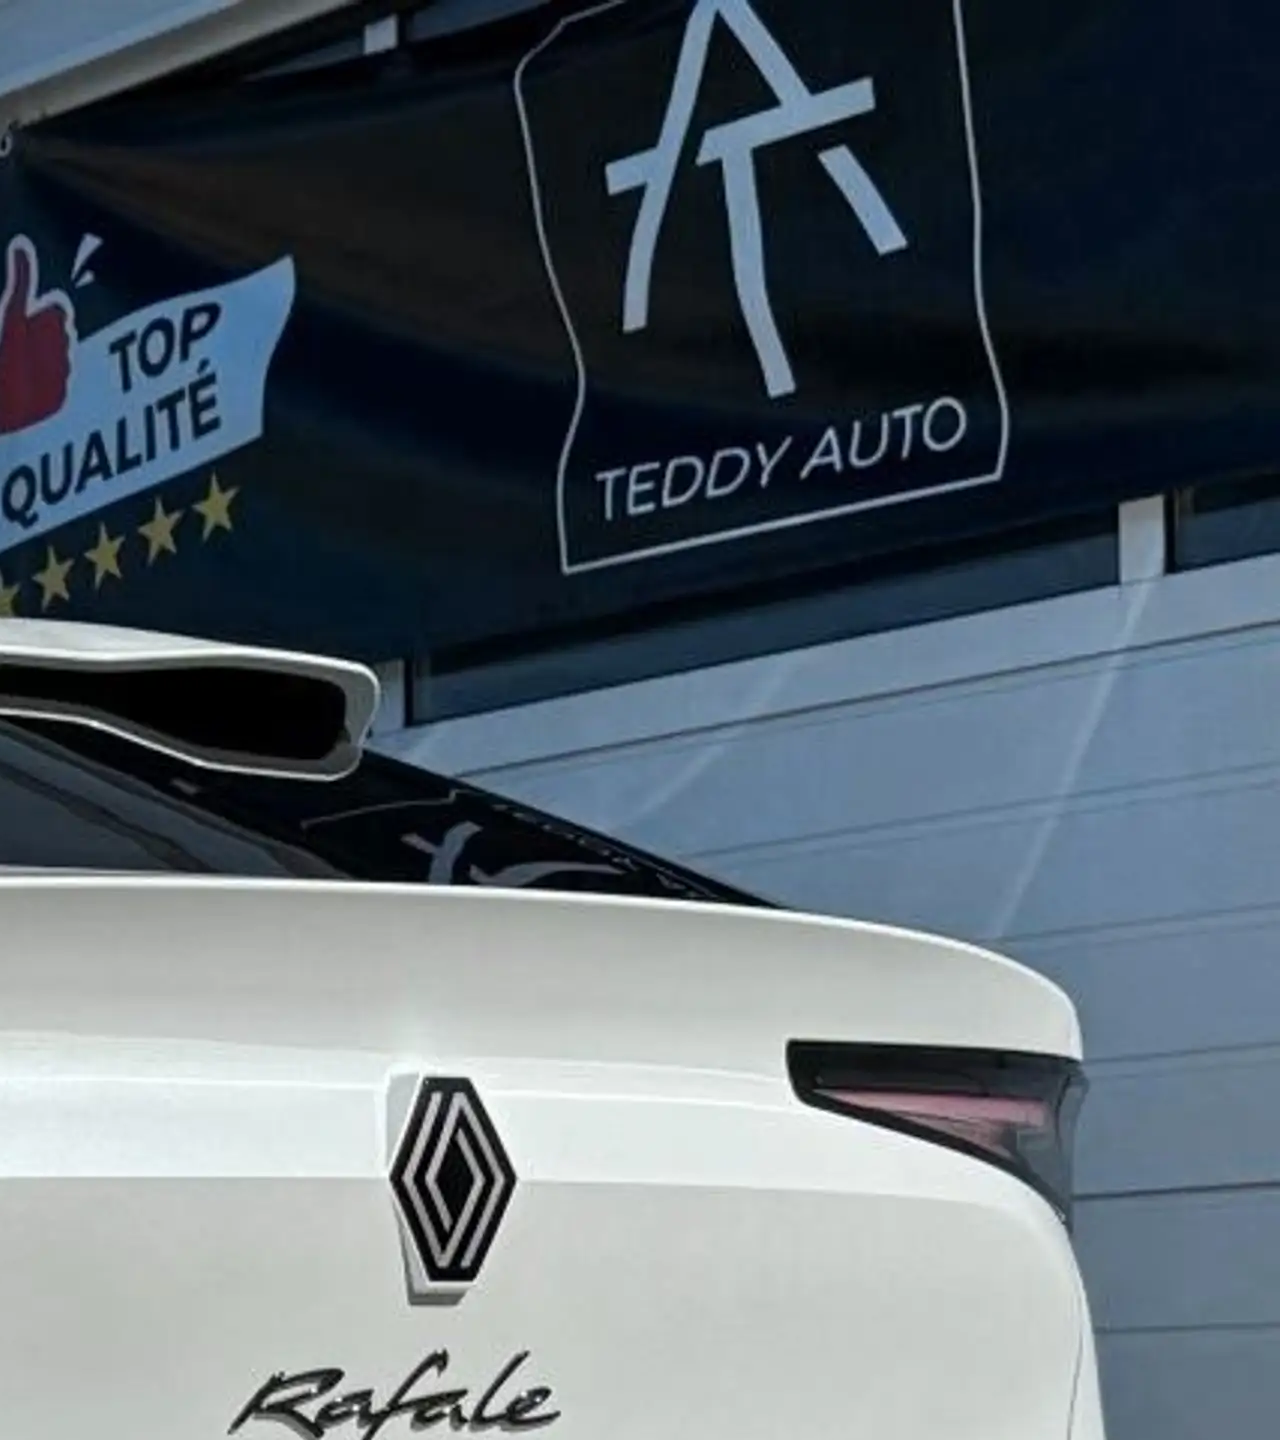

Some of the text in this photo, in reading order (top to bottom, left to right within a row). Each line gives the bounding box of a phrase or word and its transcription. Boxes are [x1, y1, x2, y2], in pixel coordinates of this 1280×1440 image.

[109, 302, 221, 393] TOP
[1, 358, 221, 528] QUALITÉ
[595, 397, 966, 521] TEDDY AUTO
